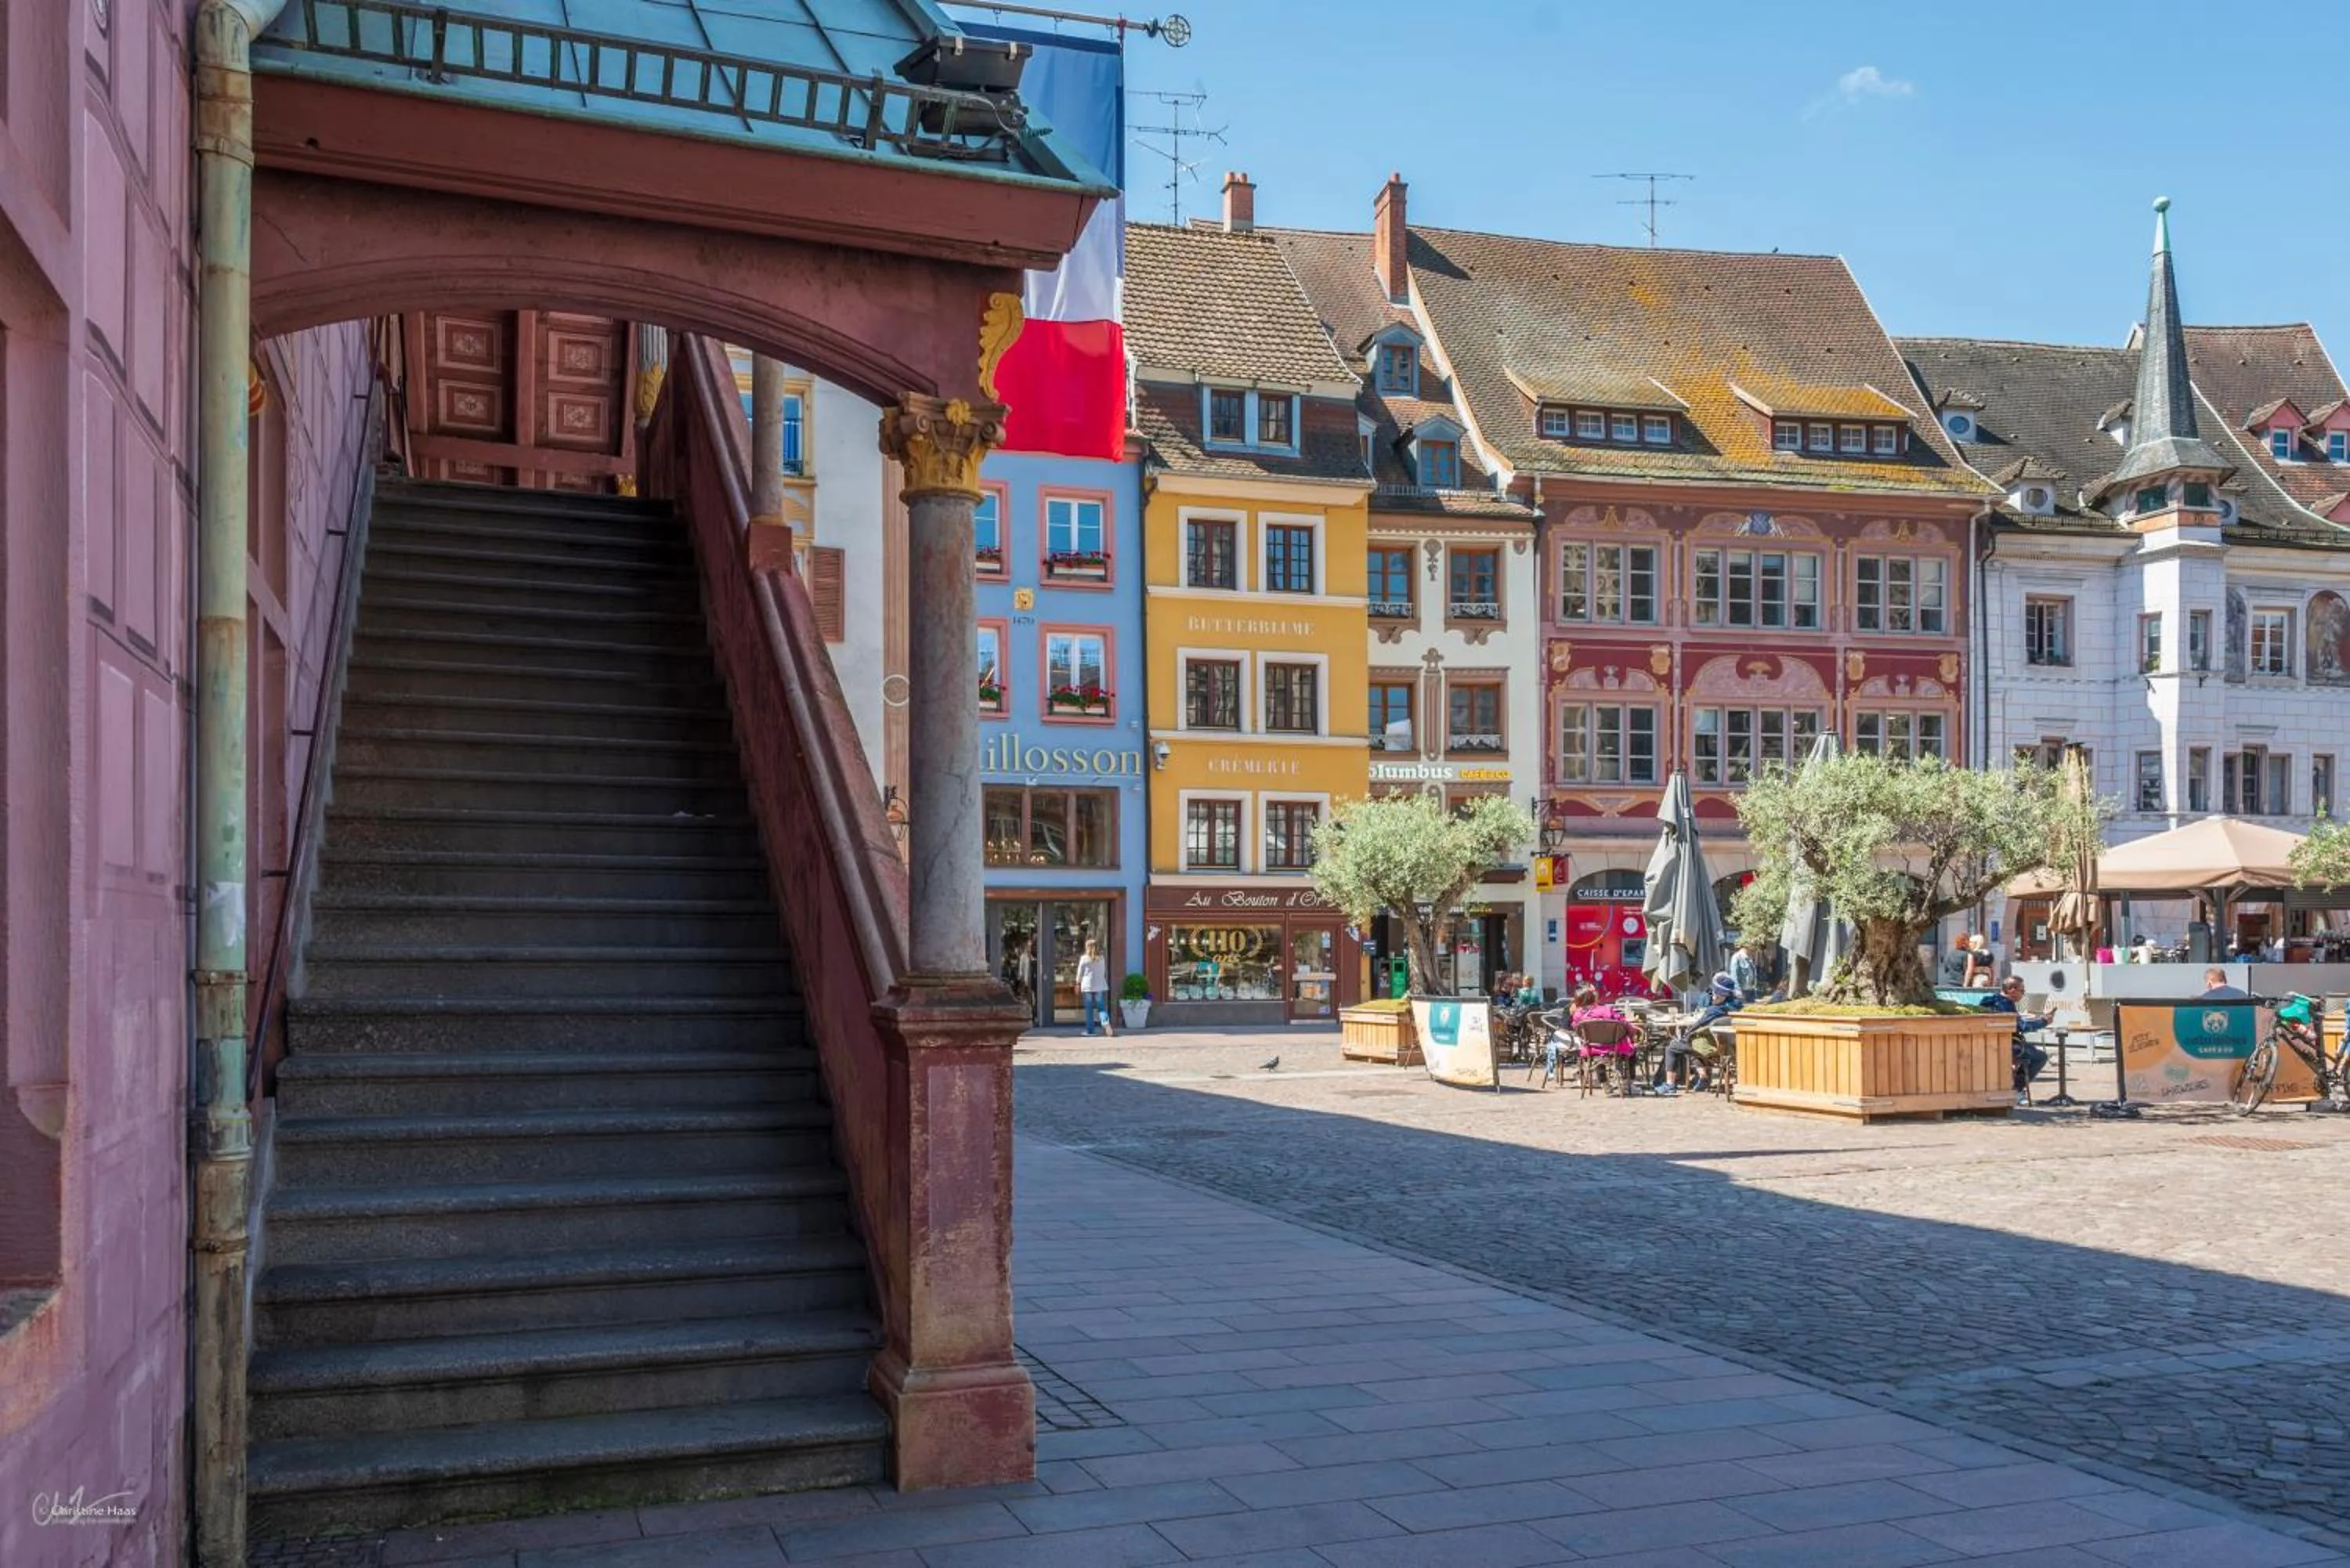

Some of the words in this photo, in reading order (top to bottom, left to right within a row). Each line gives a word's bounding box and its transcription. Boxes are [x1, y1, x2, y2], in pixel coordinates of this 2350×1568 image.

[981, 732, 1141, 775] illosson
[1368, 764, 1453, 779] olumbus
[1184, 891, 1213, 906] Au
[1221, 891, 1278, 907] Bouton
[1577, 889, 1609, 898] CAISSE
[1613, 889, 1645, 898] D'EPAR
